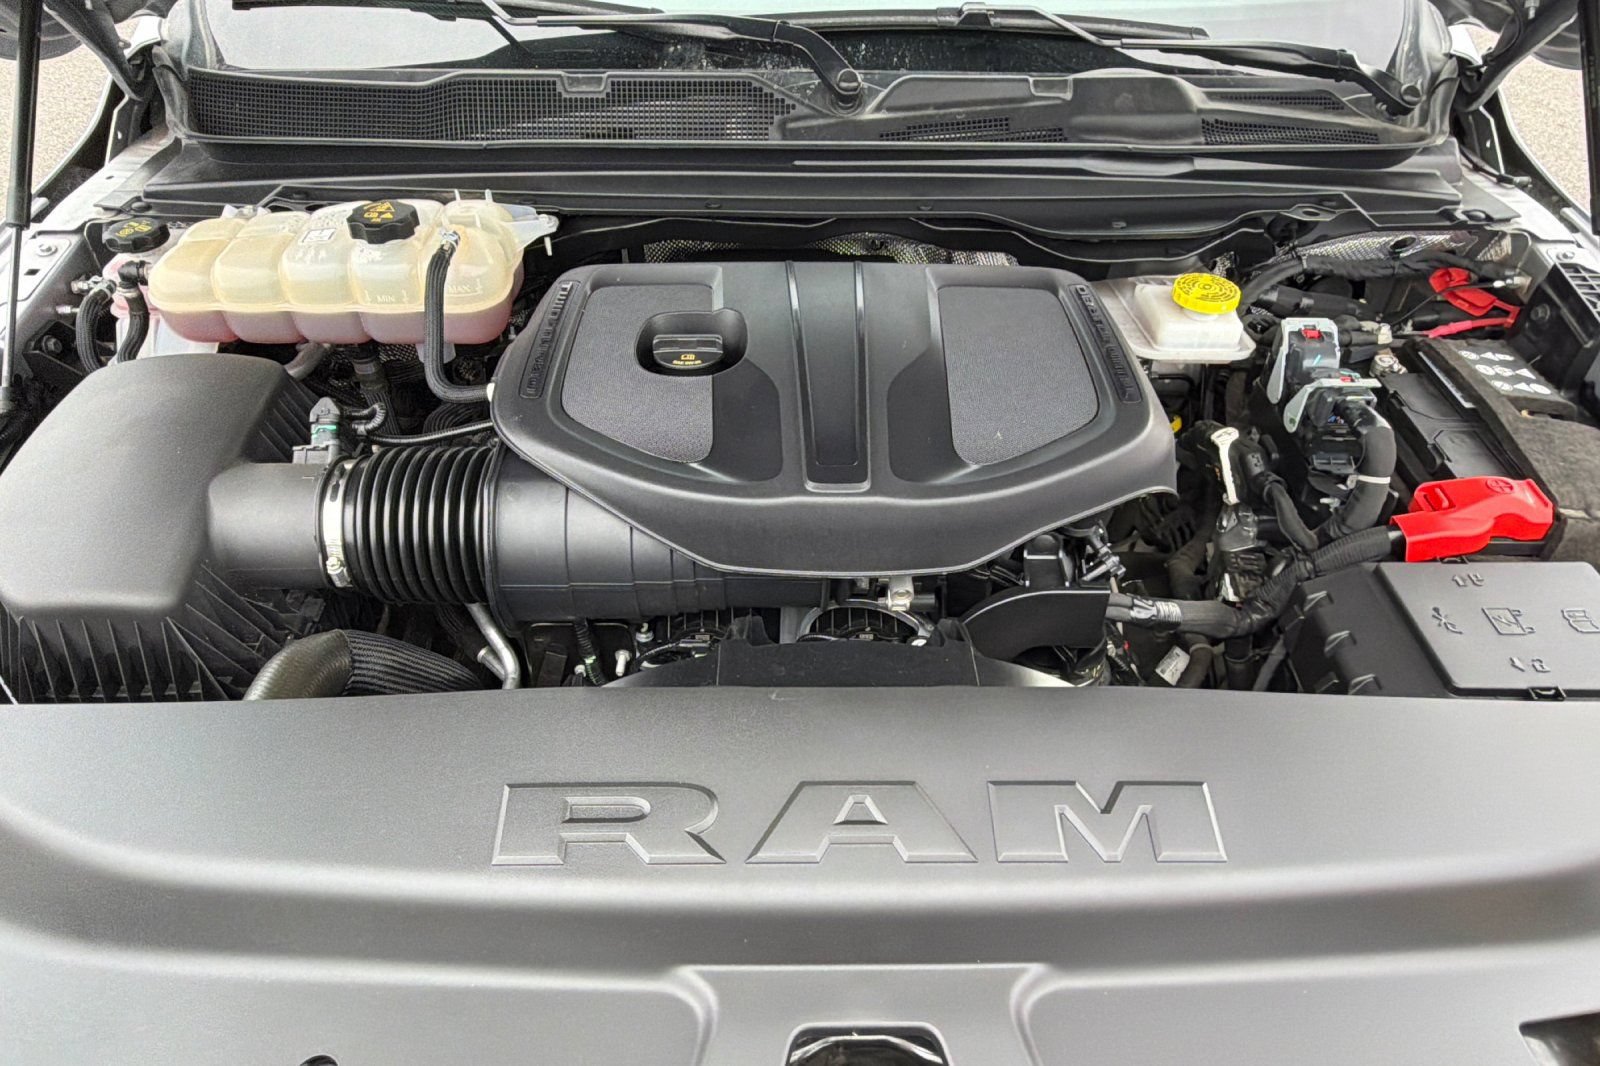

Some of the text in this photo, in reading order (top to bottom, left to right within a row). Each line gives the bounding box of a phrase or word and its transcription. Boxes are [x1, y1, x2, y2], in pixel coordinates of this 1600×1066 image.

[448, 284, 471, 294] MAX
[376, 294, 396, 303] MIN
[490, 779, 1229, 867] RAM
